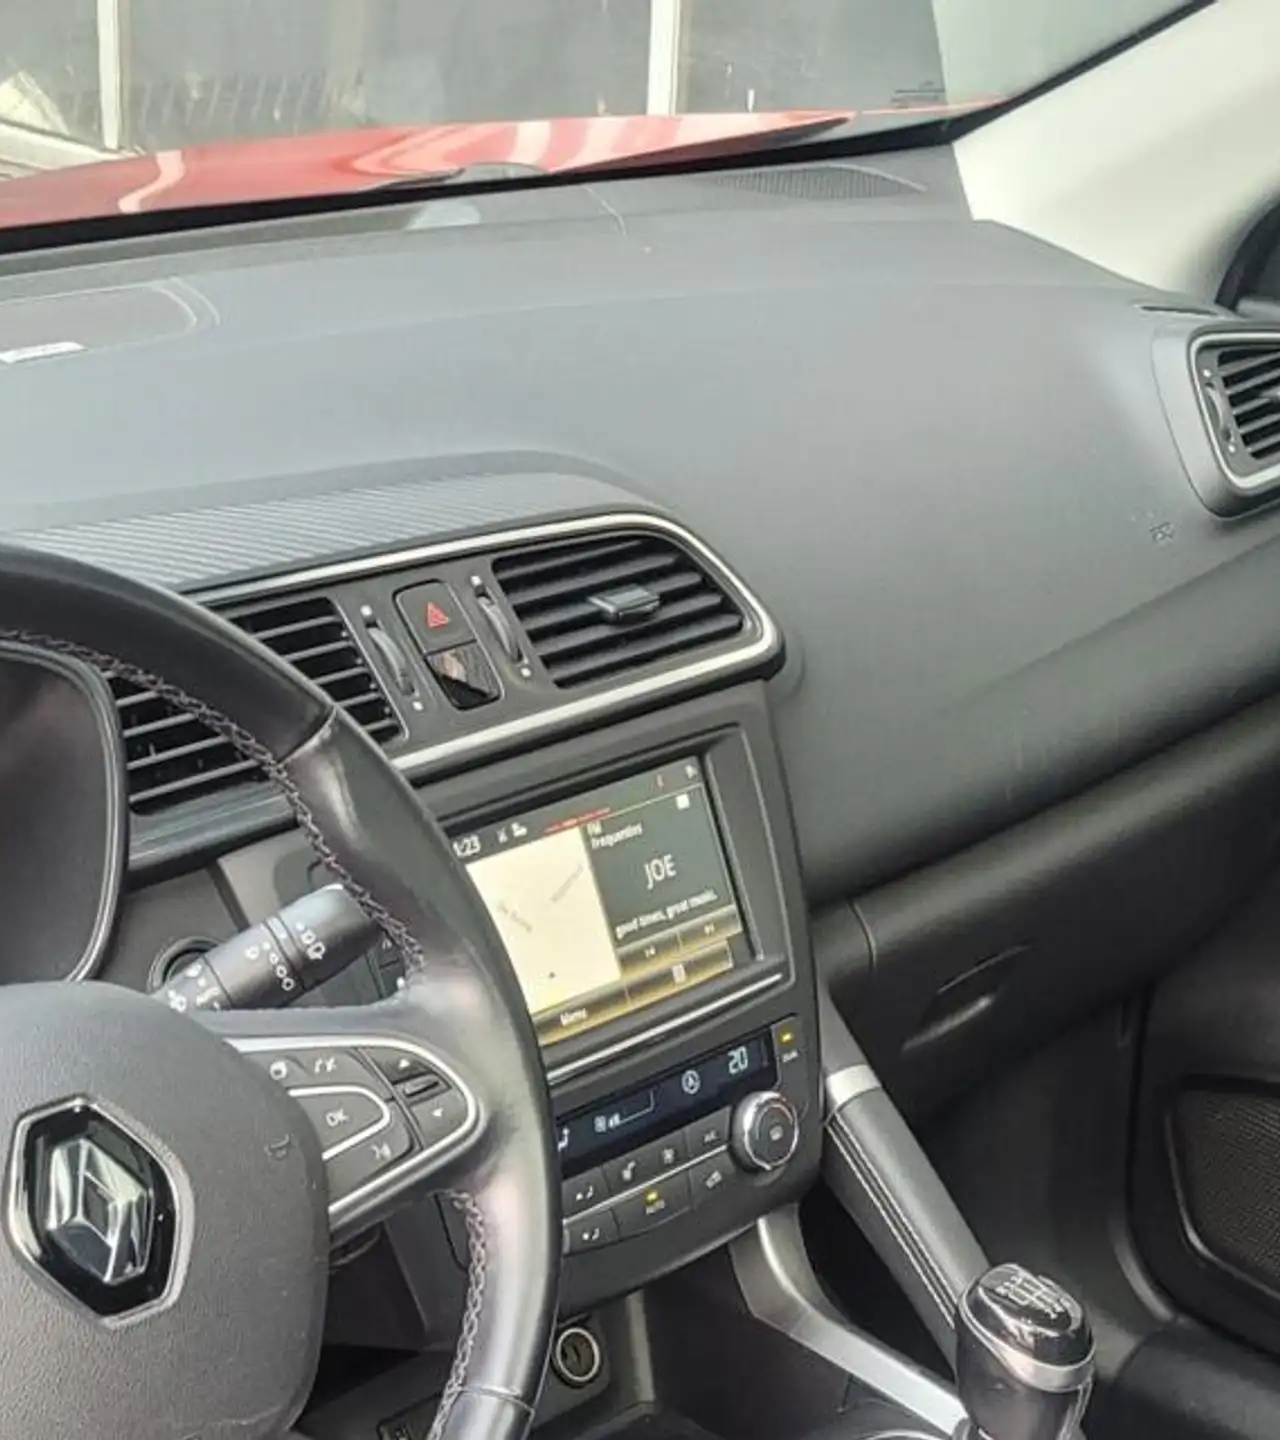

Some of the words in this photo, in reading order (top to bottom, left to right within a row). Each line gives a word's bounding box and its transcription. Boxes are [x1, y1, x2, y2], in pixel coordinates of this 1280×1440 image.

[644, 854, 677, 890] JOE
[727, 1045, 748, 1075] 20
[326, 1108, 349, 1126] OK
